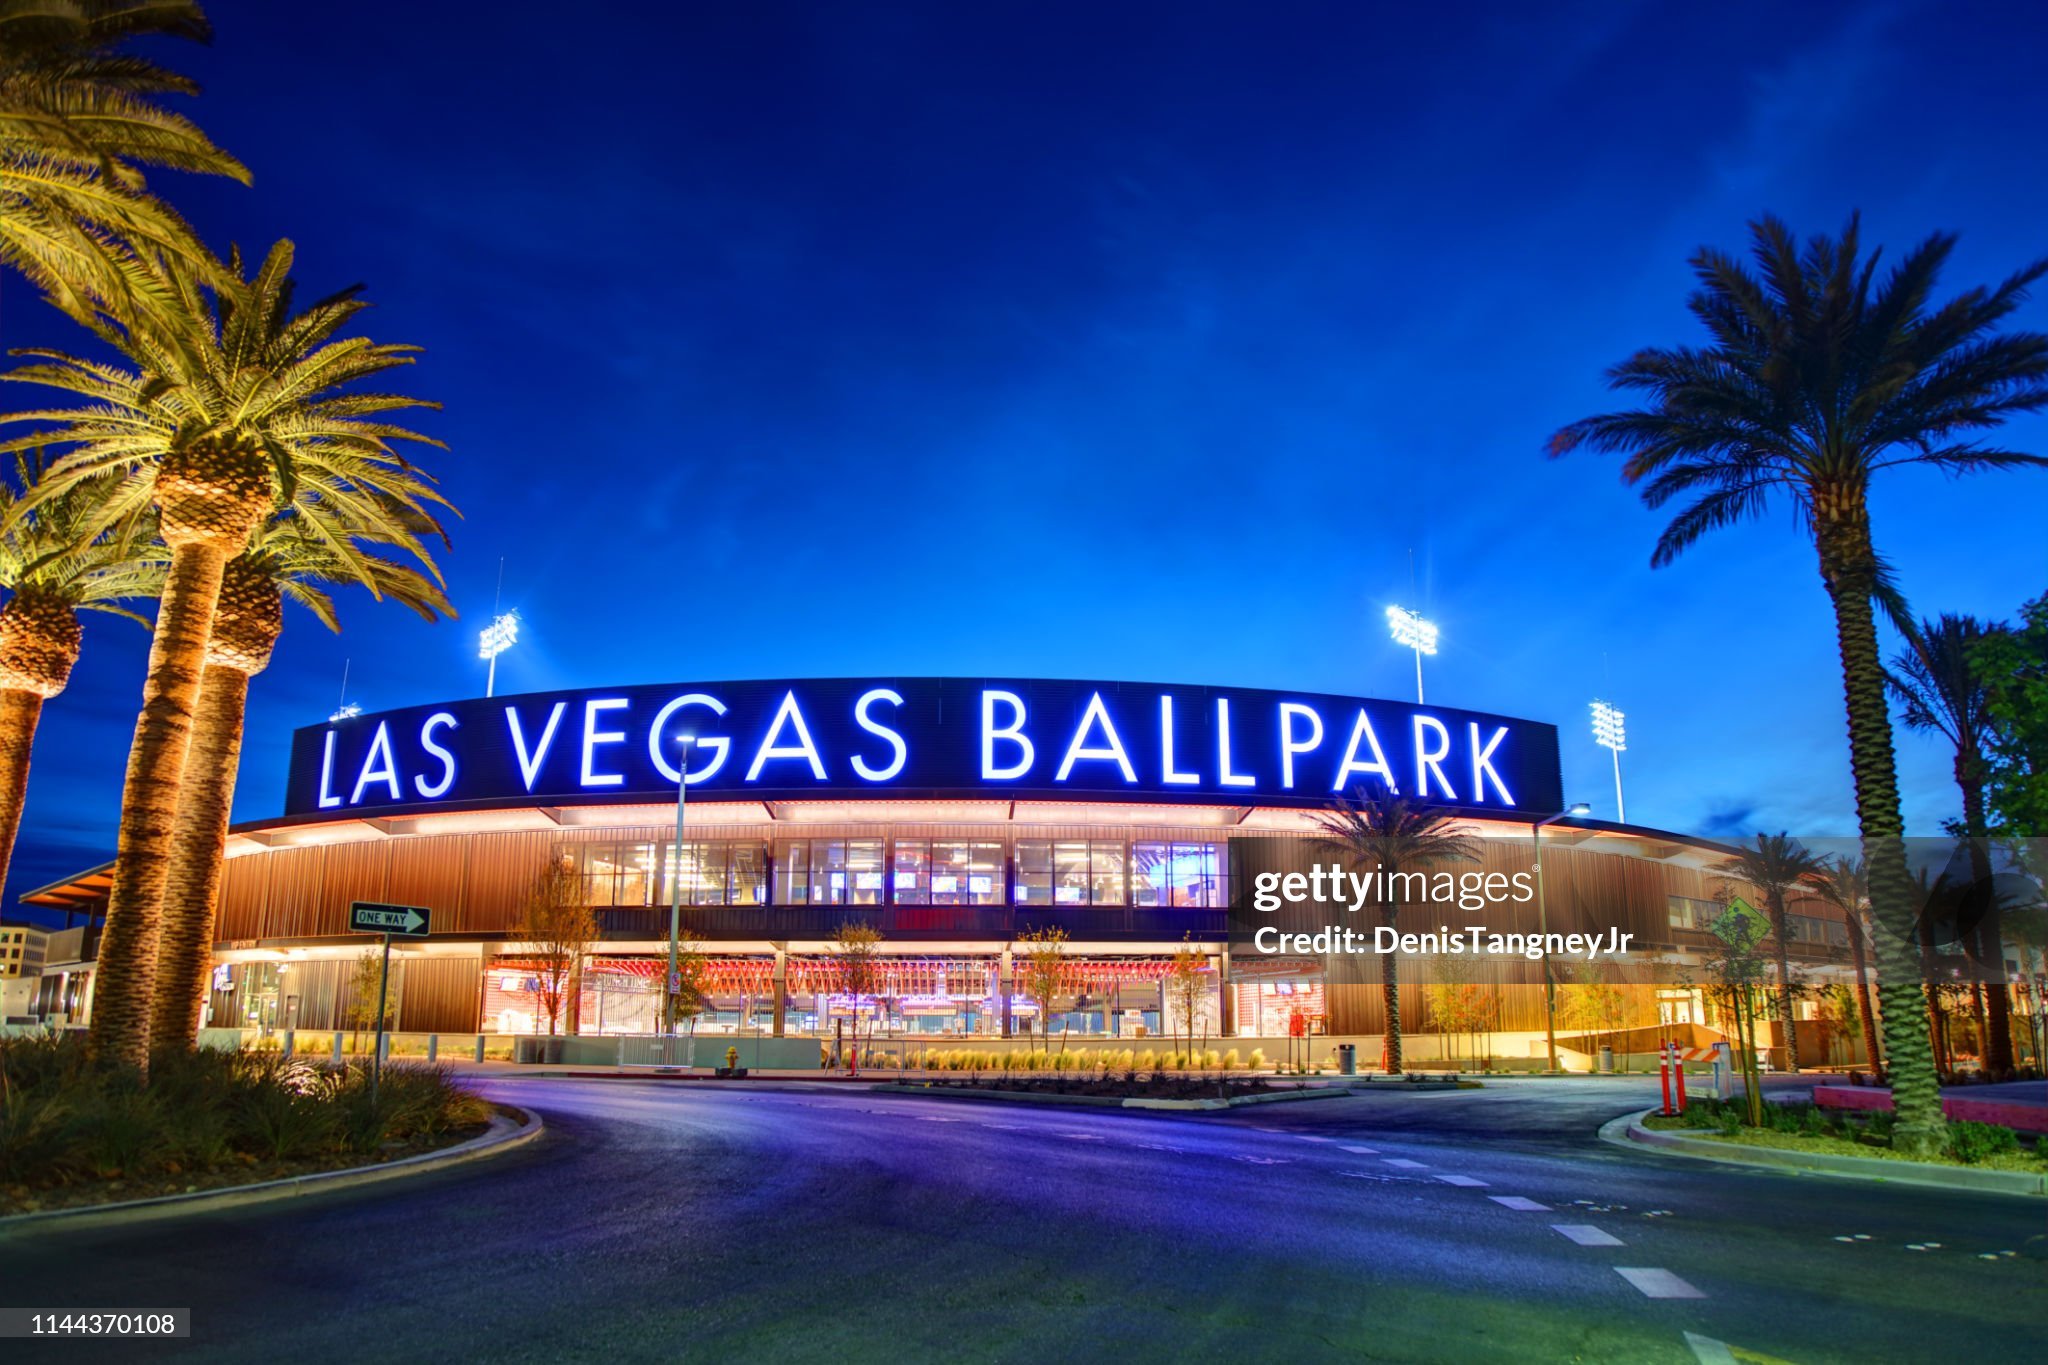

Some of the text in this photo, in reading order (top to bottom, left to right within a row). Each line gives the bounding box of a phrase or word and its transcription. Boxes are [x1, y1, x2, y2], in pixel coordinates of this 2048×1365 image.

[319, 689, 1516, 808] LAS VEGAS BALLPARK
[358, 910, 406, 926] ONE WAY
